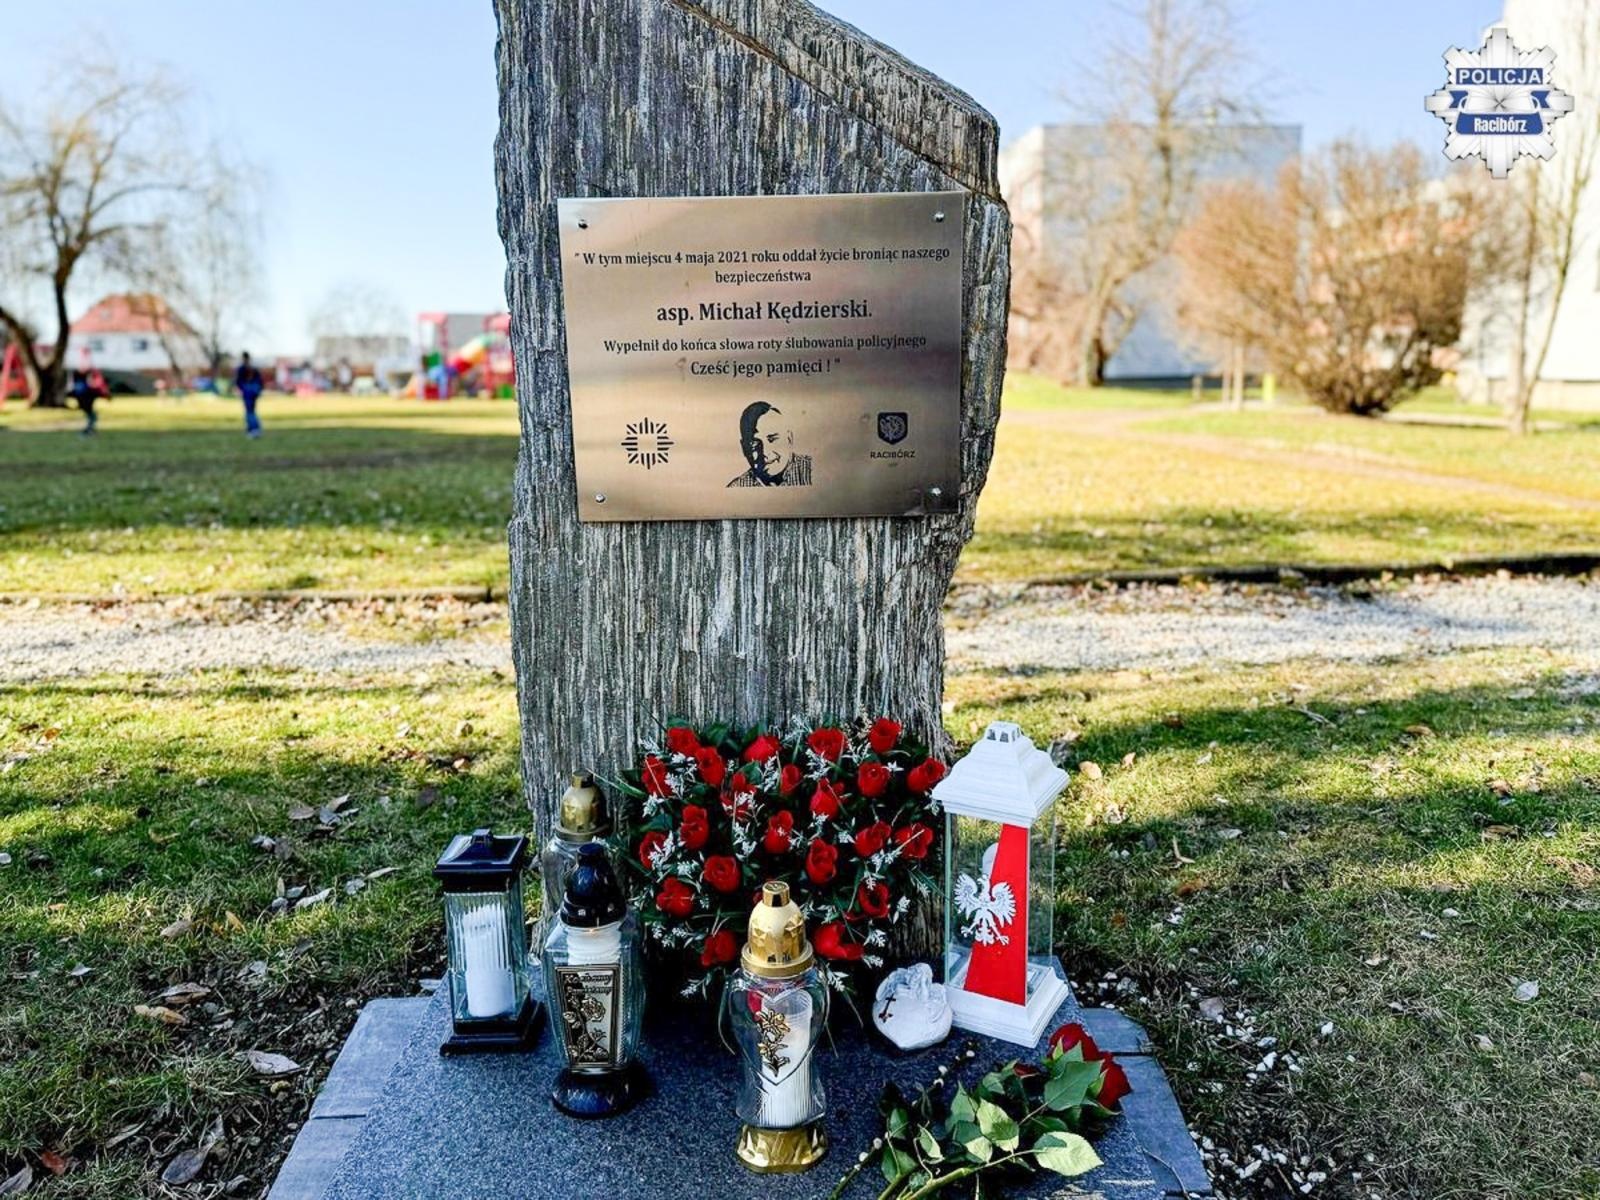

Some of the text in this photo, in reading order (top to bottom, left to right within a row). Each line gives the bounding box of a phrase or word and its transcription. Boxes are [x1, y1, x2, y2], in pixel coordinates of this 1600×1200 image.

[583, 253, 595, 264] W
[599, 253, 622, 267] tym
[625, 252, 672, 266] miejscu
[674, 252, 682, 263] 4
[686, 252, 714, 265] maja
[718, 252, 747, 262] 2021
[752, 250, 780, 262] roku
[783, 249, 816, 262] oddał
[819, 248, 849, 264] życie
[853, 248, 898, 262] broniąc
[901, 247, 950, 261] naszego
[715, 269, 811, 285] bezpieczeństwa
[657, 300, 872, 325] asp. Michał Kędzierski.
[604, 335, 926, 354] Wypełnił do końca słowa roty ślubowania policyjnego
[691, 361, 729, 375] Cześć
[733, 361, 762, 377] jego
[767, 359, 822, 376] pamięci
[870, 450, 916, 458] RACIBÓRZ
